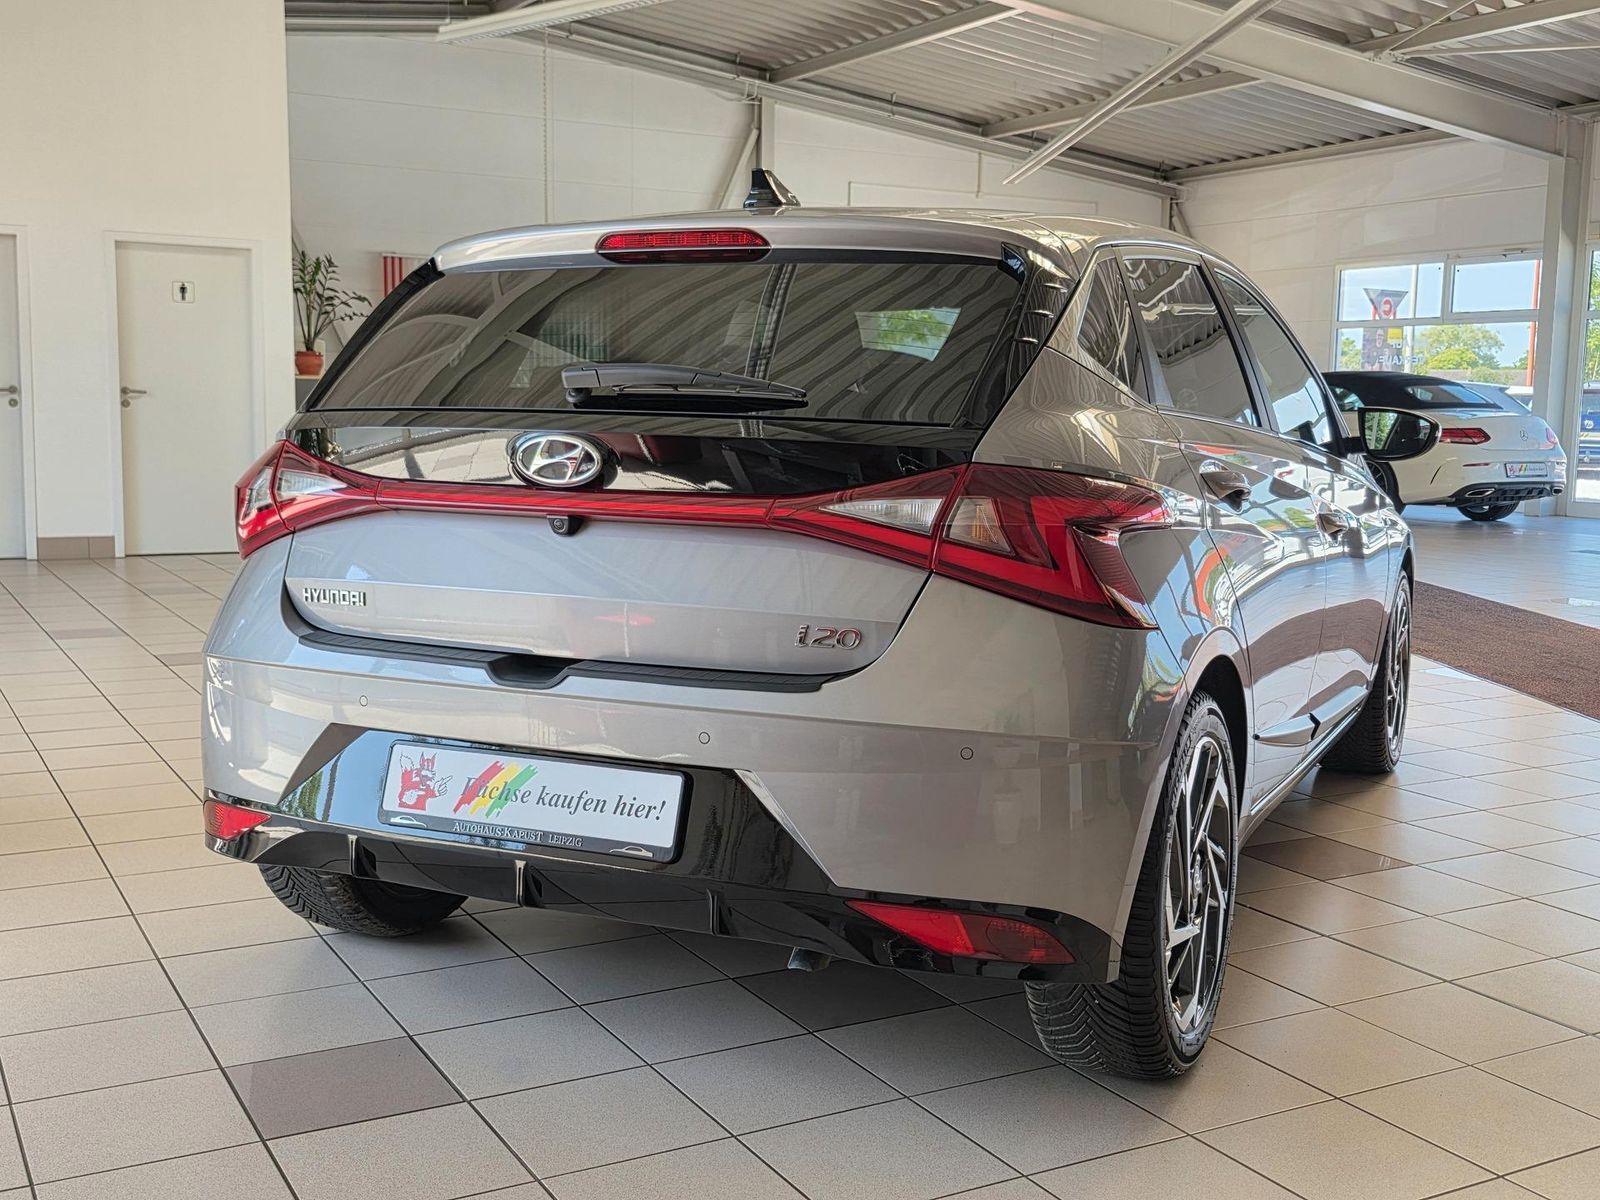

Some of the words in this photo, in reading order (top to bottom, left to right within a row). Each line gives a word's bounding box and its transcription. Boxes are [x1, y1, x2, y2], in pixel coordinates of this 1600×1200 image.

[303, 588, 366, 606] HYUNDAI
[461, 777, 532, 804] Füchse
[536, 785, 607, 816] kaufen
[612, 794, 667, 821] hier!
[548, 833, 583, 847] LEIPZIG
